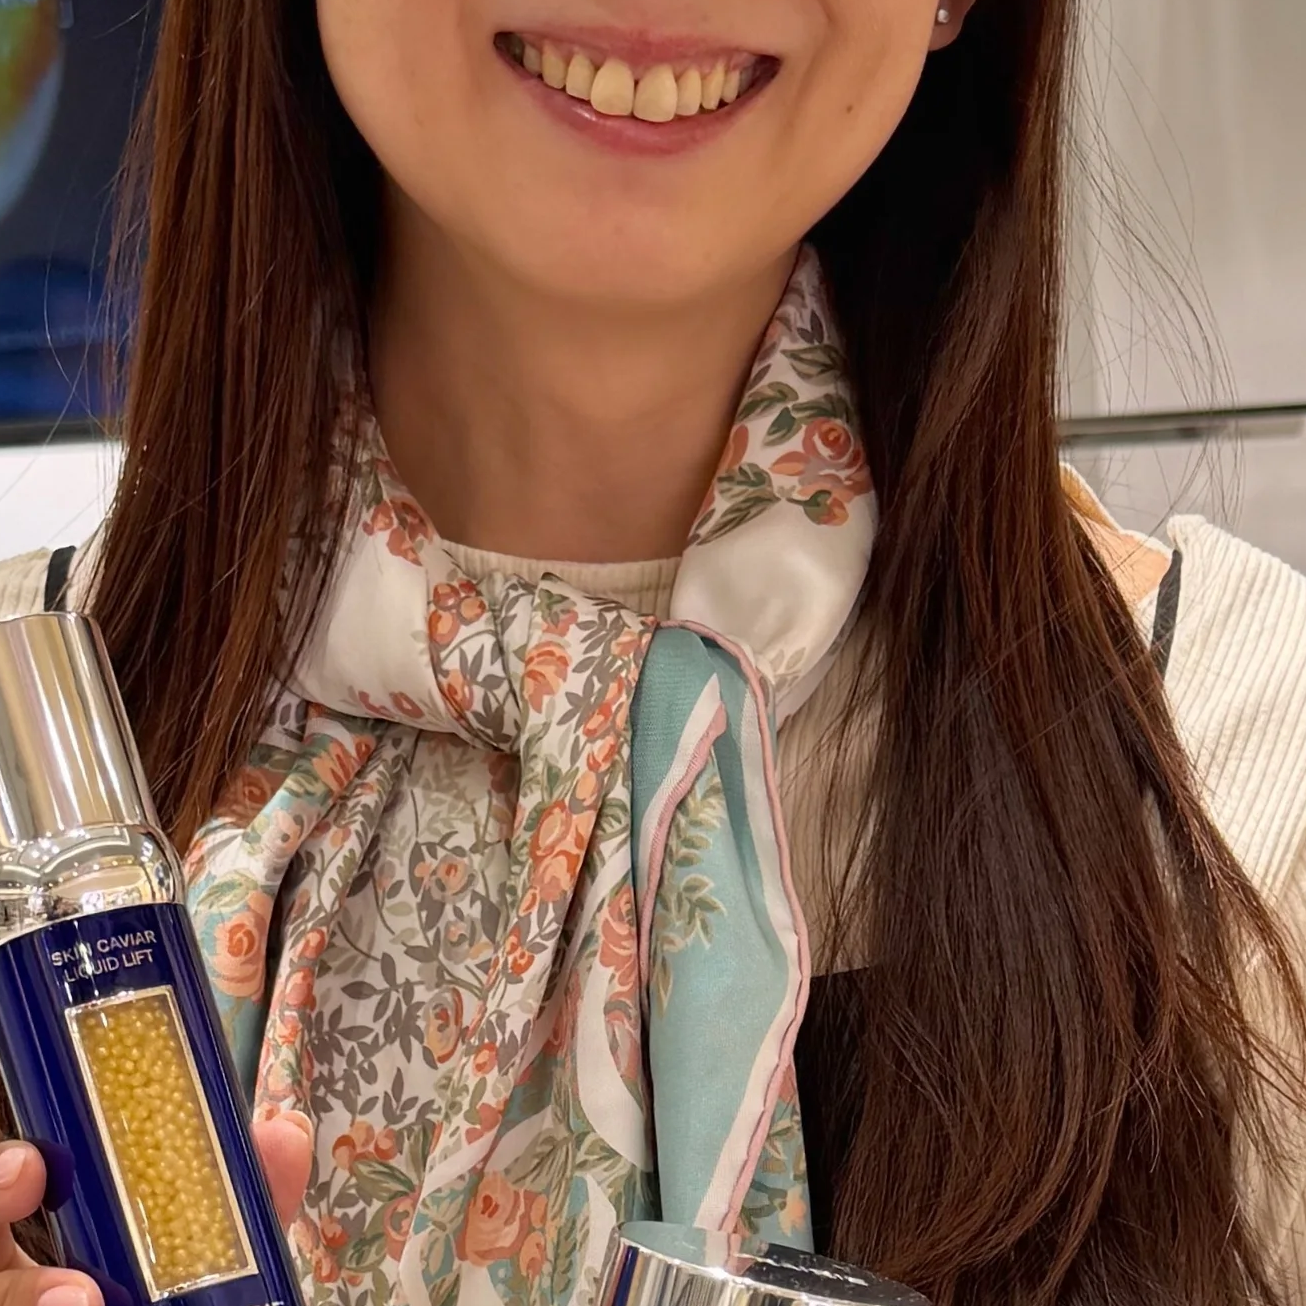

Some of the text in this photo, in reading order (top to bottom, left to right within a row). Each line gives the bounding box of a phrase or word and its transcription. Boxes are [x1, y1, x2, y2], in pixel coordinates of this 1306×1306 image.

[51, 930, 157, 967] SKIN CAVIAR
[64, 949, 154, 983] LIQUID LIFT
